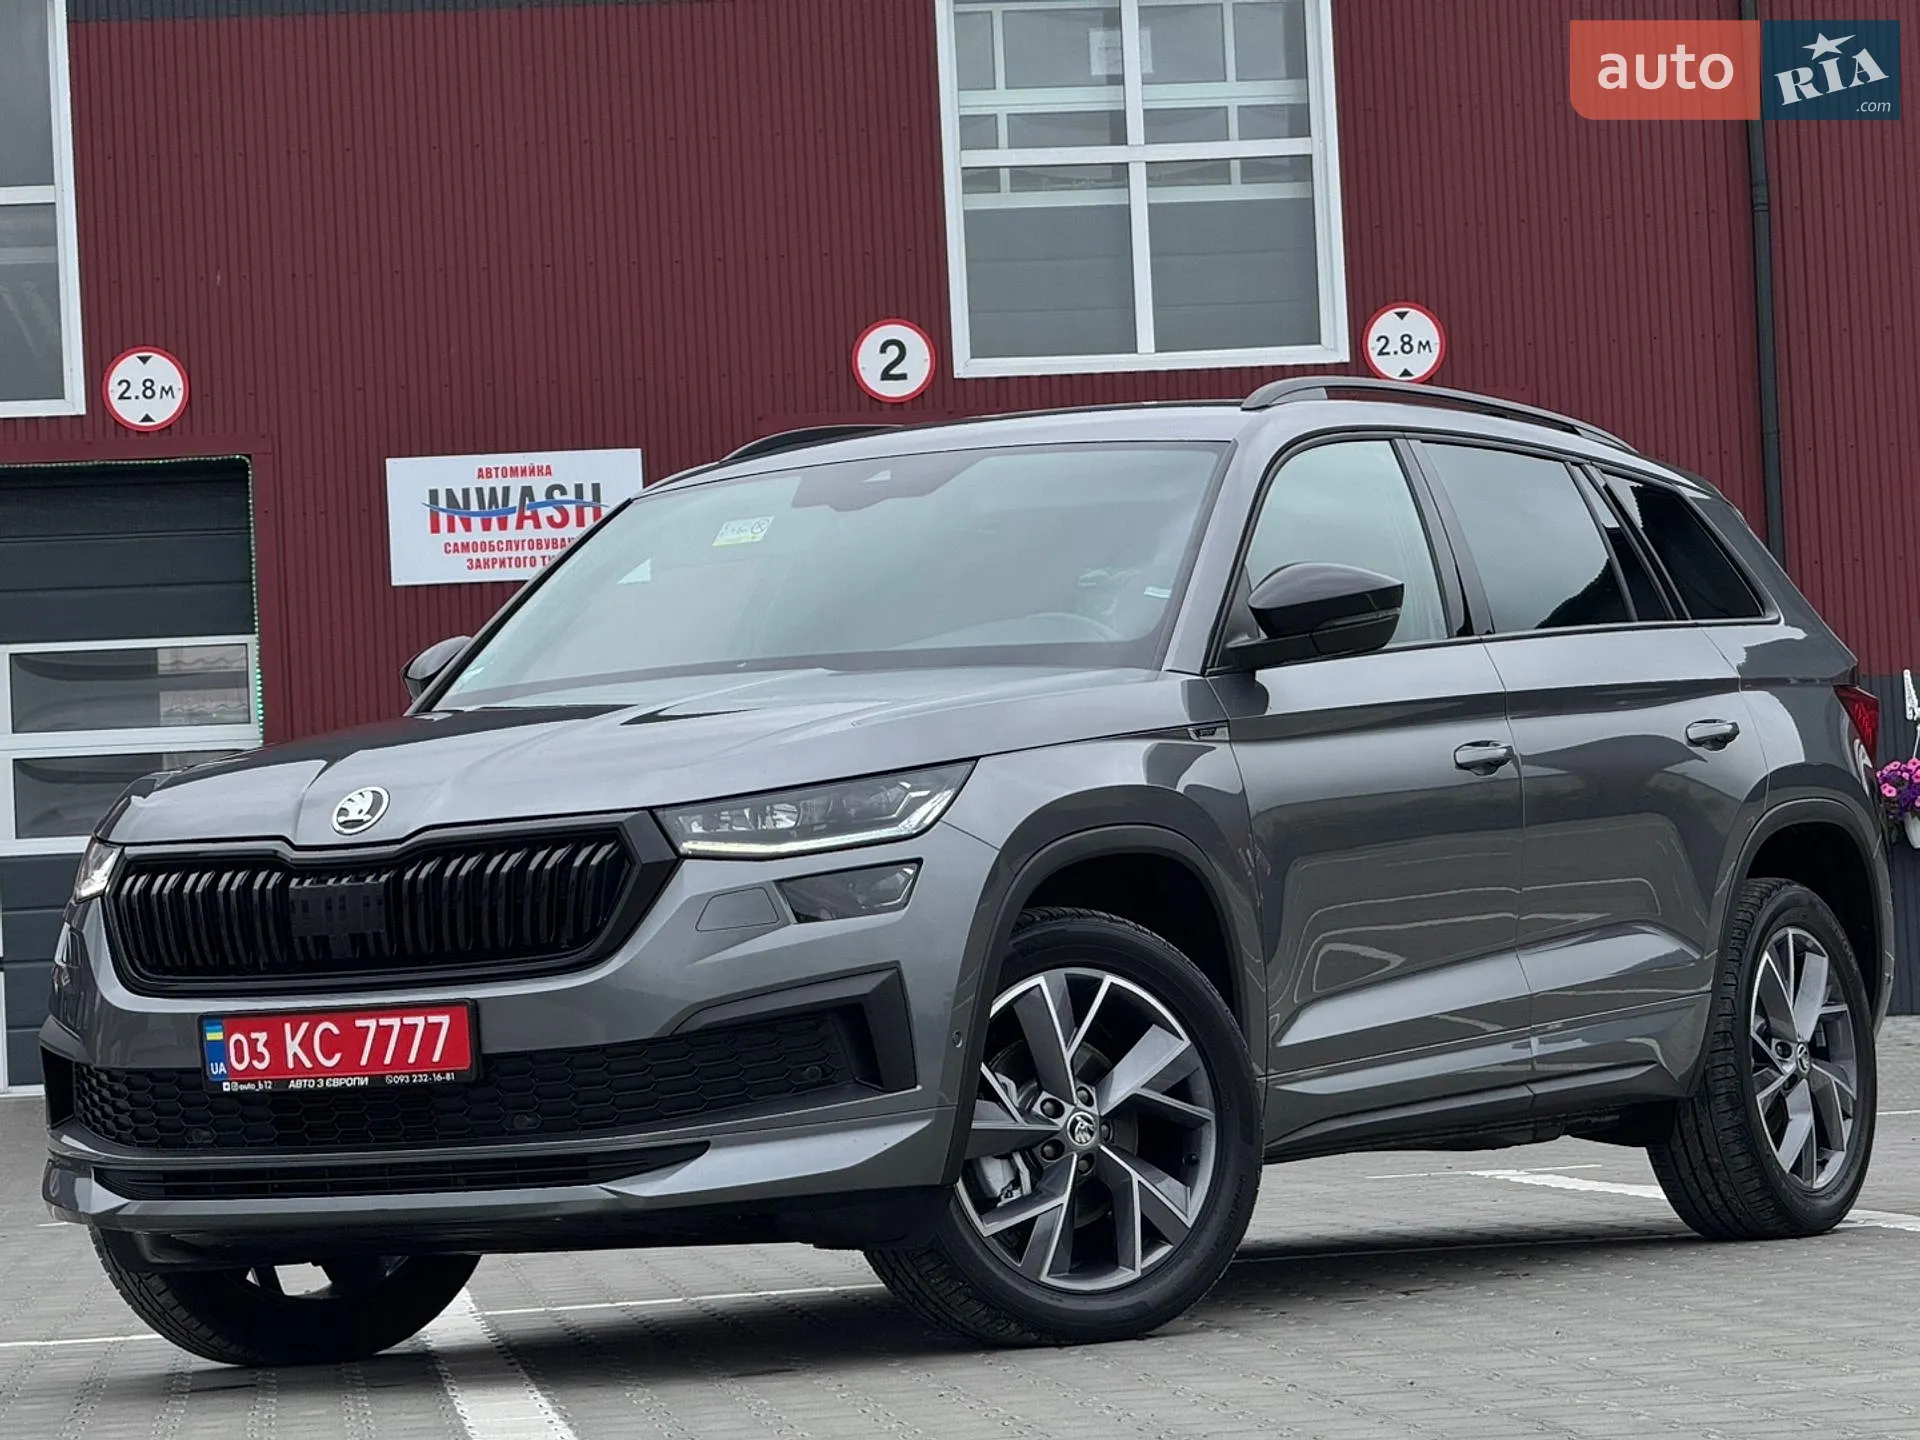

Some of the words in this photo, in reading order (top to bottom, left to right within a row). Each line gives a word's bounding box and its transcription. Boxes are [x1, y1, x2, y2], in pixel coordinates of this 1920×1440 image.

[879, 338, 908, 381] 2
[476, 463, 553, 480] АВТОМИЙКА
[428, 482, 603, 534] INWASH
[443, 537, 575, 555] САМООБСЛУГОВУВА
[466, 556, 537, 571] ЗАКРИТОГО
[229, 1031, 271, 1071] 03
[355, 1014, 450, 1066] 7777
[210, 1062, 227, 1075] UA
[288, 1079, 315, 1089] АВТО
[394, 1074, 410, 1084] 093
